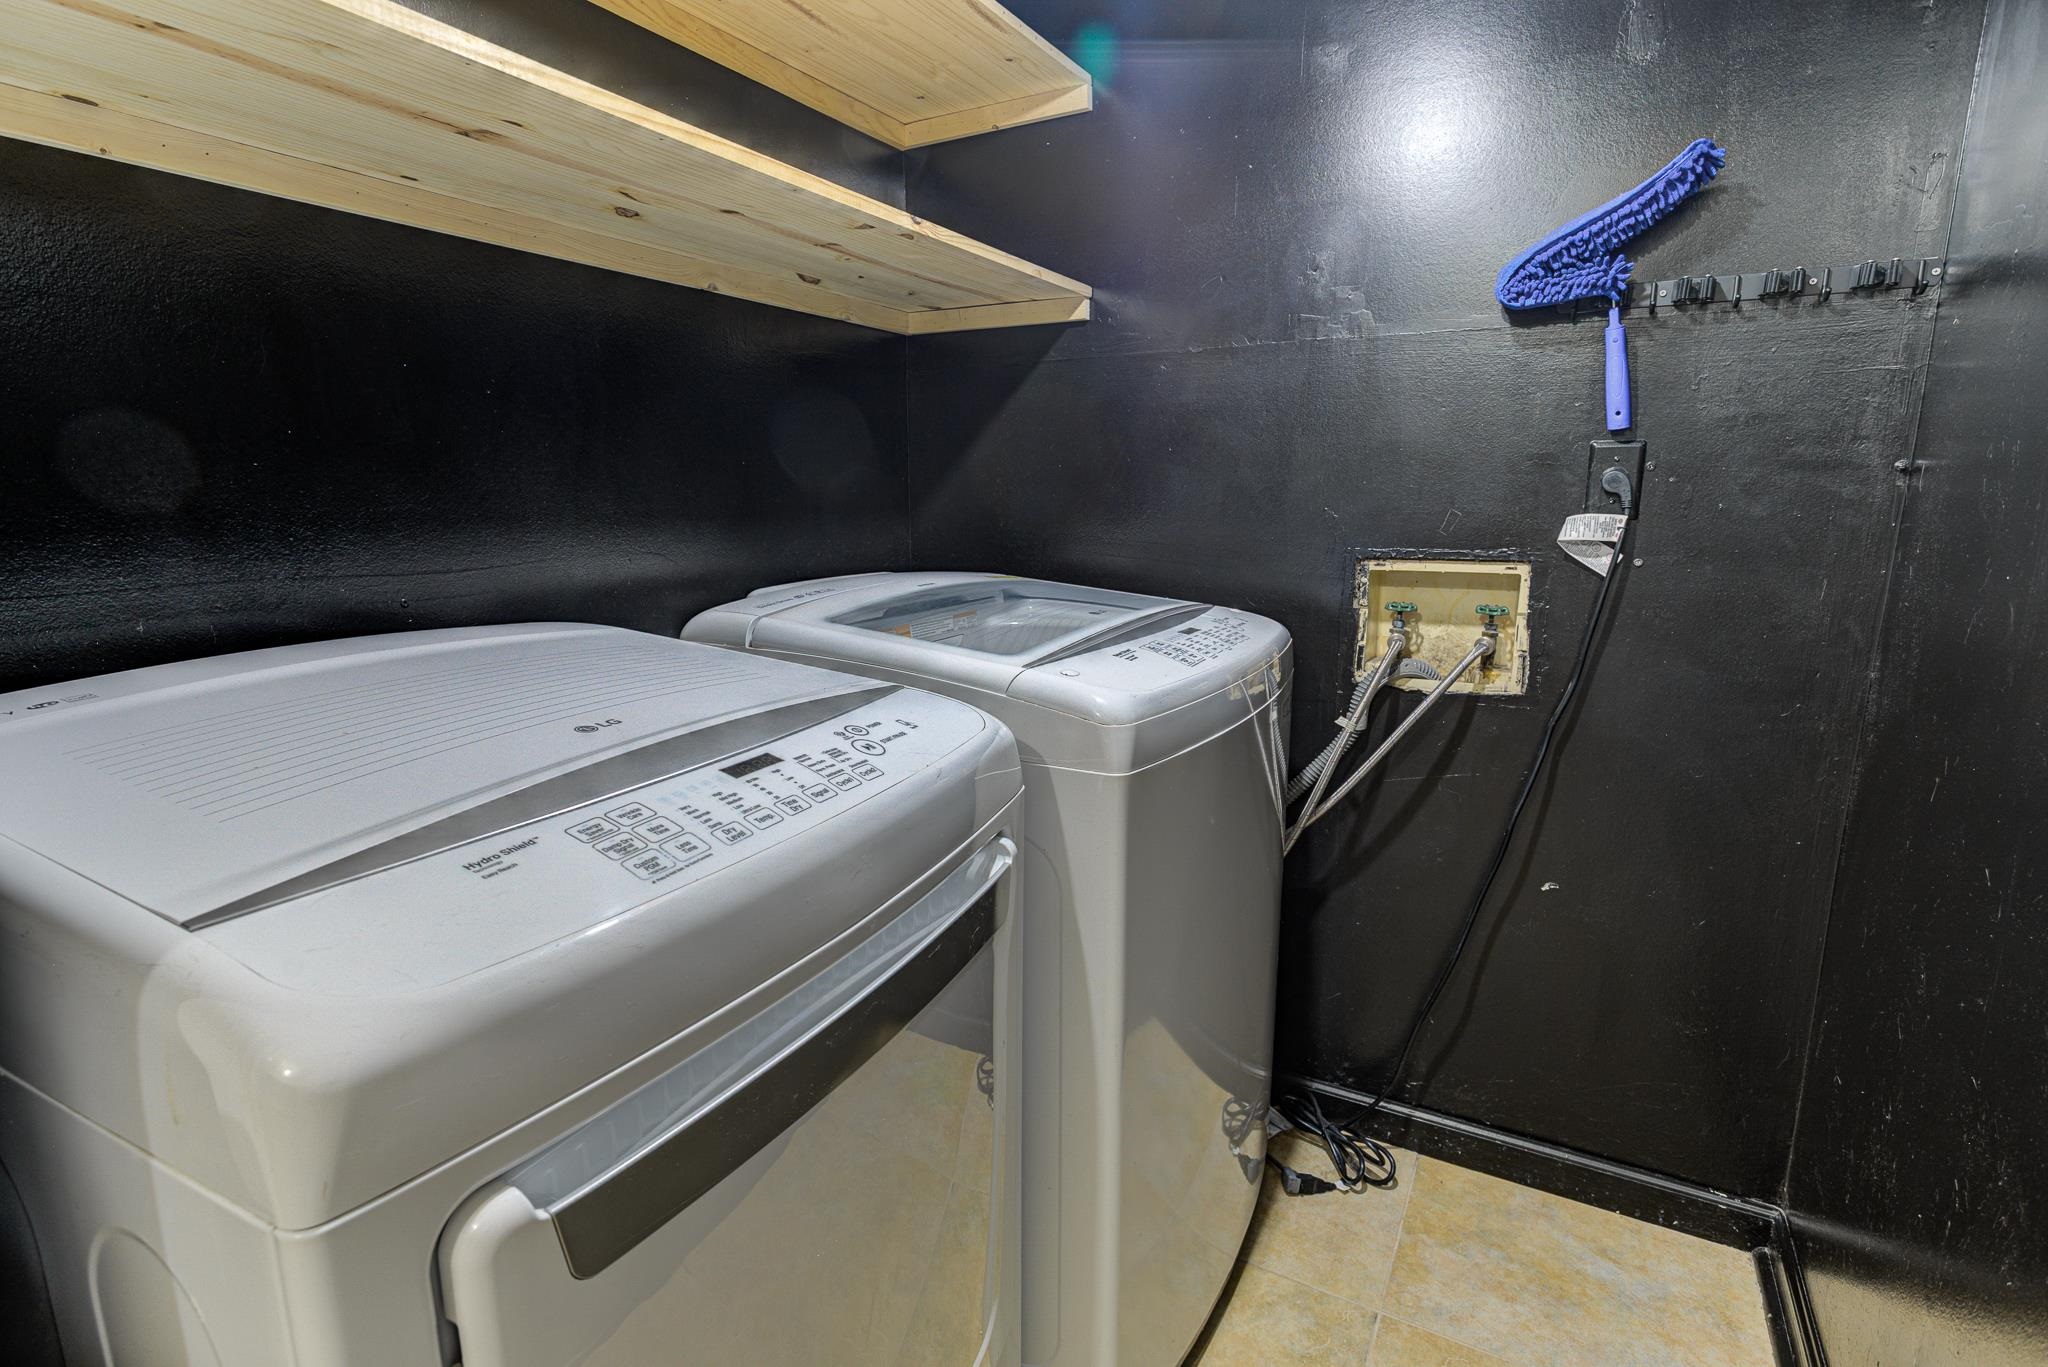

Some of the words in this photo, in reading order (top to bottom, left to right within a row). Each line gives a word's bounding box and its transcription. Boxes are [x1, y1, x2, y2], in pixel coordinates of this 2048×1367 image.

[595, 718, 622, 728] LG
[780, 799, 799, 807] Time
[789, 804, 804, 812] Dry
[654, 827, 671, 835] Time
[721, 827, 737, 835] Dry
[725, 830, 747, 842] Level
[675, 841, 692, 850] Less
[682, 845, 699, 853] Time
[462, 854, 501, 871] Hydro
[633, 856, 660, 869] Custom
[643, 861, 661, 871] PGM
